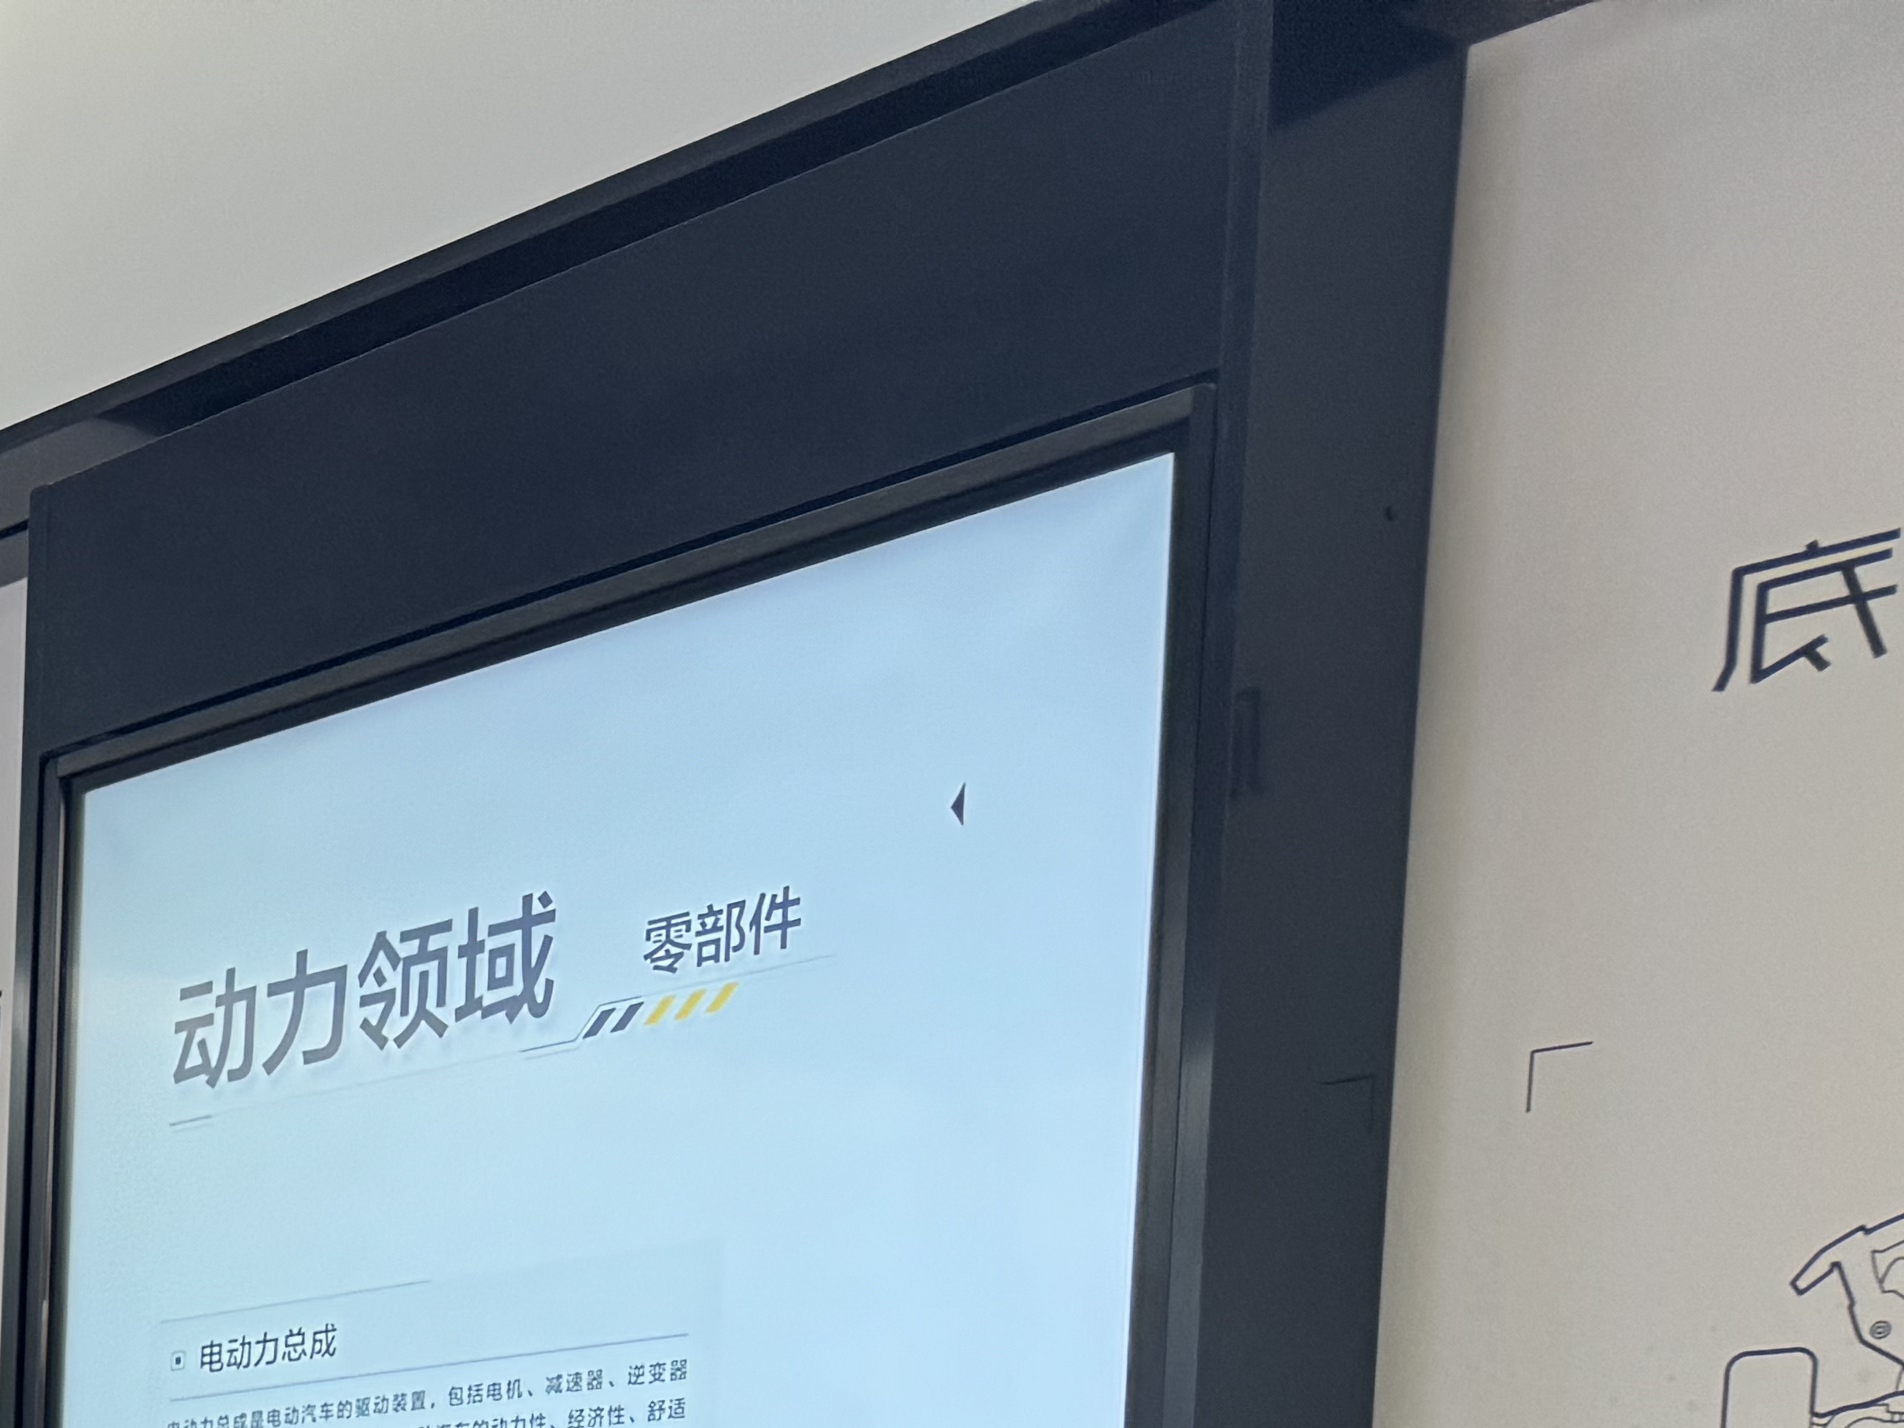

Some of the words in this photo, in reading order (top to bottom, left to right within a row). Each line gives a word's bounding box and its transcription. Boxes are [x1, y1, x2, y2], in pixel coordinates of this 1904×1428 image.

[1711, 527, 1902, 693] 底
[172, 891, 556, 1088] 动力领域
[643, 886, 801, 973] 零部件
[199, 1323, 337, 1374] 电动力总成
